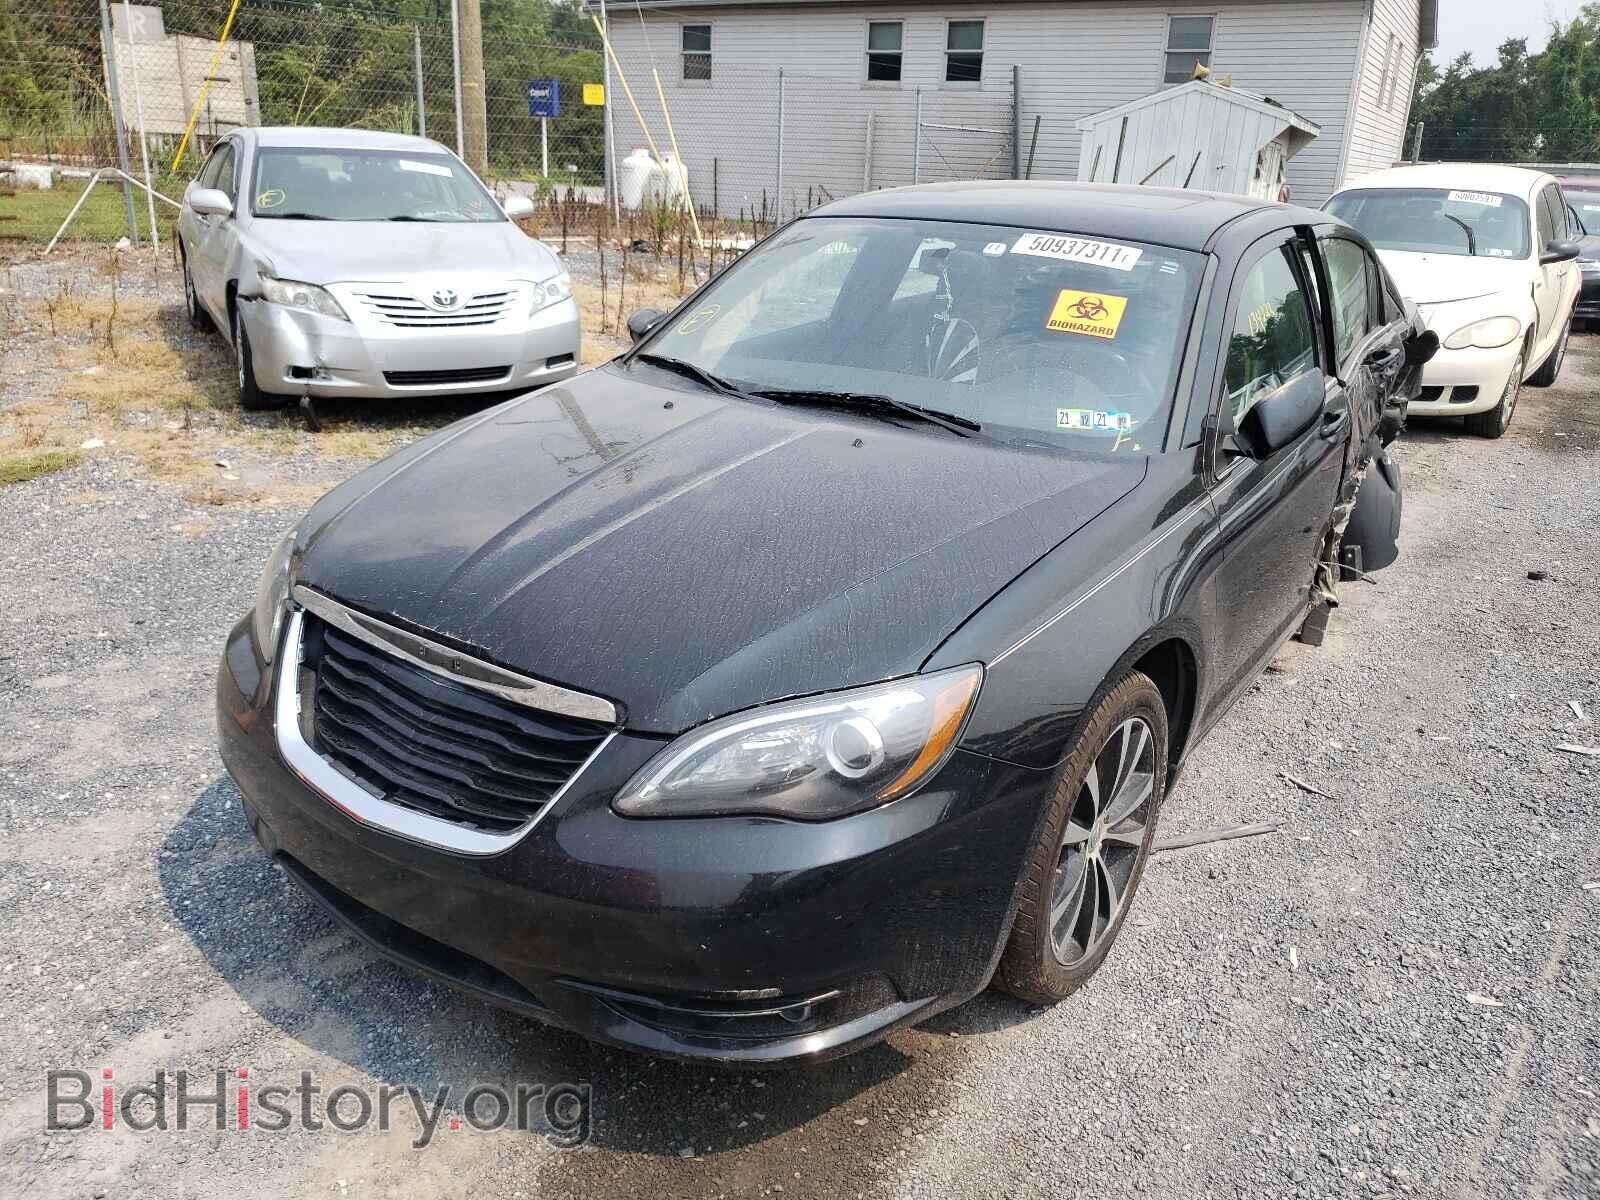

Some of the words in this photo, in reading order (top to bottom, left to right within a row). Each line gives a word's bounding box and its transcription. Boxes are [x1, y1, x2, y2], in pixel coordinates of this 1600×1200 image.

[1029, 236, 1123, 263] 50937311
[1049, 319, 1114, 336] BIOHAZARD
[1059, 411, 1070, 425] 21
